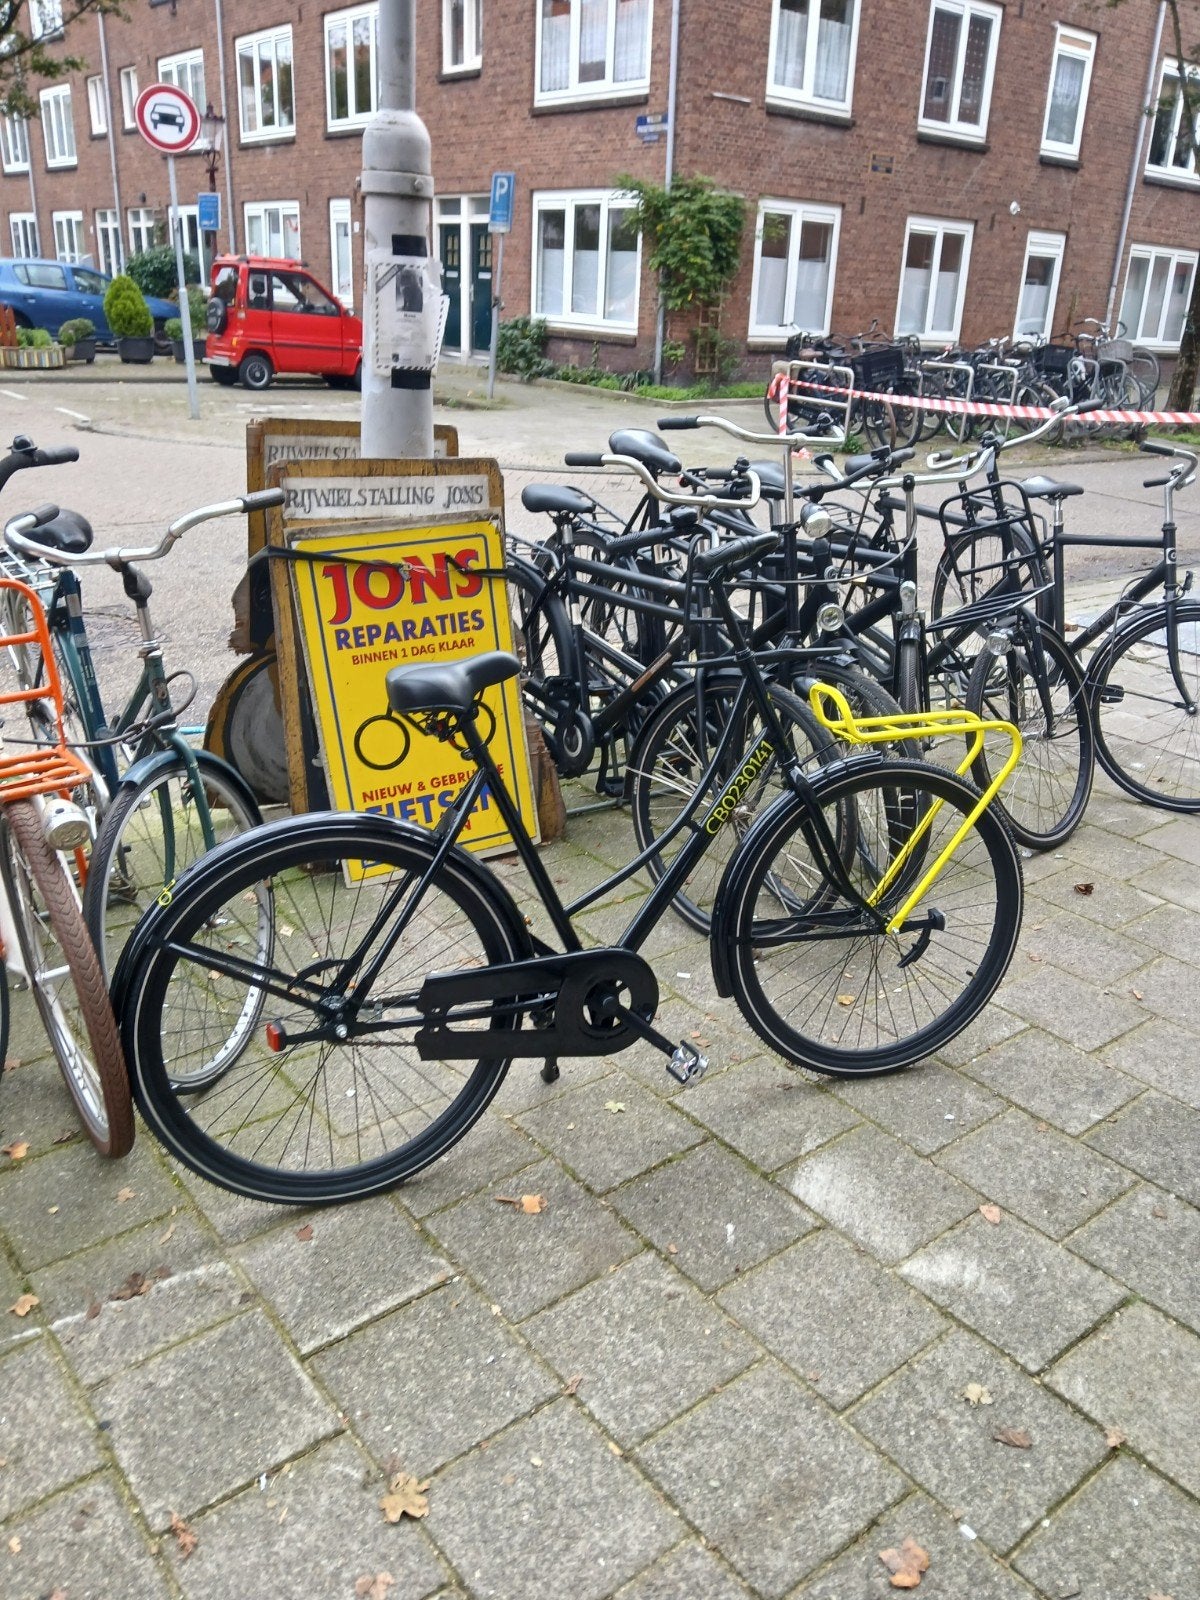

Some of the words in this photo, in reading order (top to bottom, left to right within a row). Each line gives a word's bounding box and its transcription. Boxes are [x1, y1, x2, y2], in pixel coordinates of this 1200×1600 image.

[496, 177, 508, 203] P
[284, 486, 434, 514] RIJWIELSTALLING
[442, 485, 484, 508] JONS
[322, 549, 484, 625] JONS
[335, 609, 485, 651] REPARATIES
[352, 651, 398, 665] BINNEN
[401, 647, 408, 658] 1
[411, 644, 436, 656] DAG
[438, 637, 475, 652] KLAAR
[362, 782, 412, 802] NIEUW
[417, 781, 426, 791] &
[430, 763, 504, 788] GEBRUE
